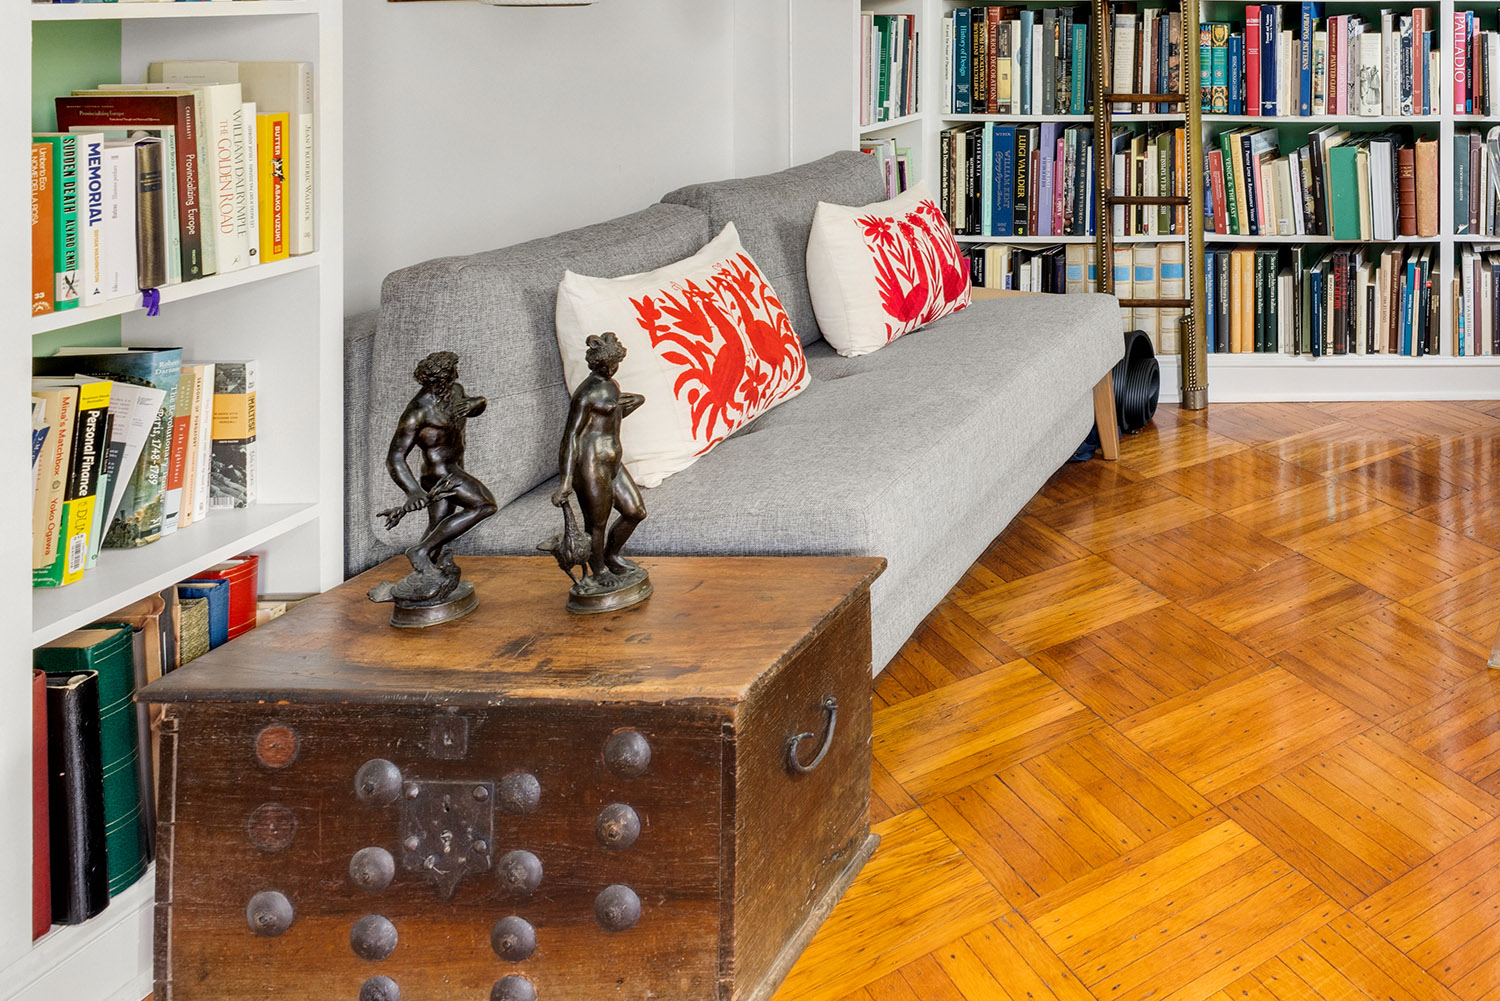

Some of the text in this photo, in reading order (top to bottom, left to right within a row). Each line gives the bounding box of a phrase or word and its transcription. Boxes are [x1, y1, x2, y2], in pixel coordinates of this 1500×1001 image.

[959, 25, 967, 47] History
[959, 55, 967, 76] Design
[1454, 16, 1465, 82] PALLADIO
[39, 148, 47, 174] Umberto
[64, 138, 75, 177] SUDDEN
[88, 143, 101, 226] MEMORIAL
[218, 121, 233, 233] THE GOLDEN ROAD
[233, 110, 247, 238] WILLIAM DALRYMPLE
[1017, 135, 1026, 198] LUIGI VALADIER
[64, 182, 75, 213] DEATH
[185, 155, 197, 234] Provincializing Europe
[65, 219, 75, 246] ALVARO
[44, 397, 70, 555] Mina's Matchbox Yoko Ogawa
[79, 410, 99, 496] Personal Finance
[174, 447, 183, 482] Lighthouse
